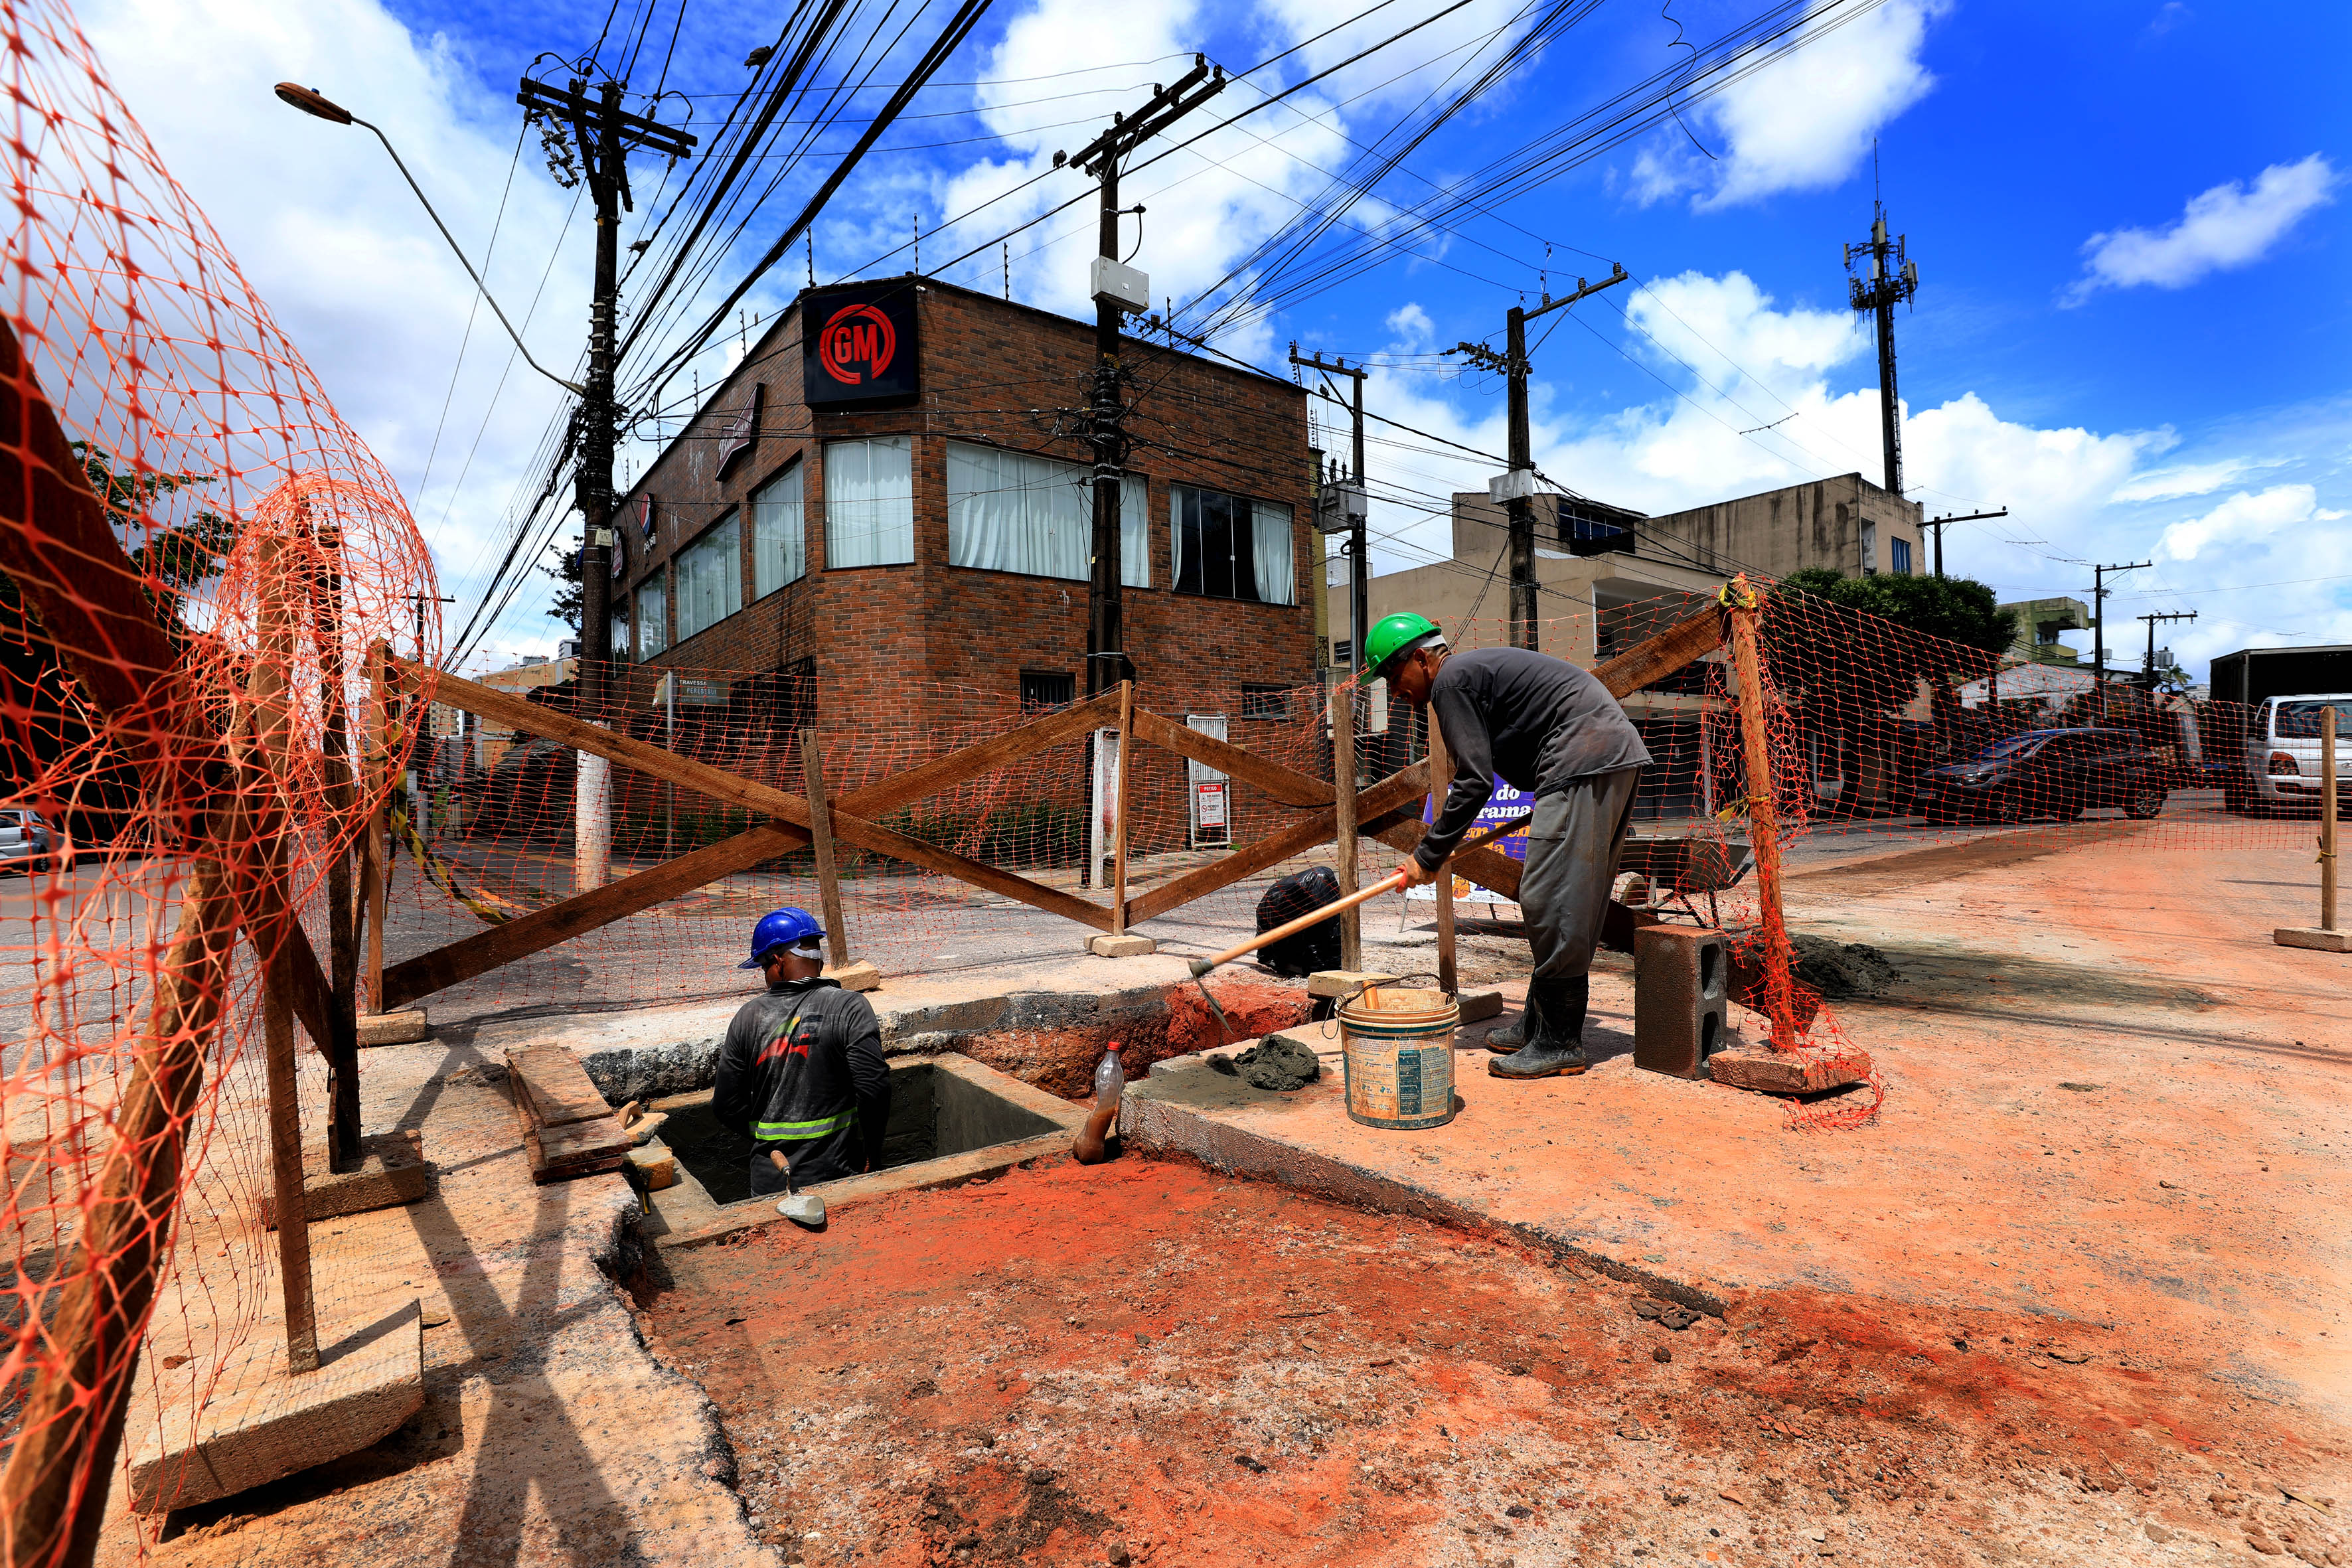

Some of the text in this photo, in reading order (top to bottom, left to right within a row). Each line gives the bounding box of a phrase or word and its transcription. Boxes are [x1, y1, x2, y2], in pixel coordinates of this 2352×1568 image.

[834, 324, 878, 364] GM
[1496, 784, 1520, 801] do
[1476, 805, 1531, 819] rama
